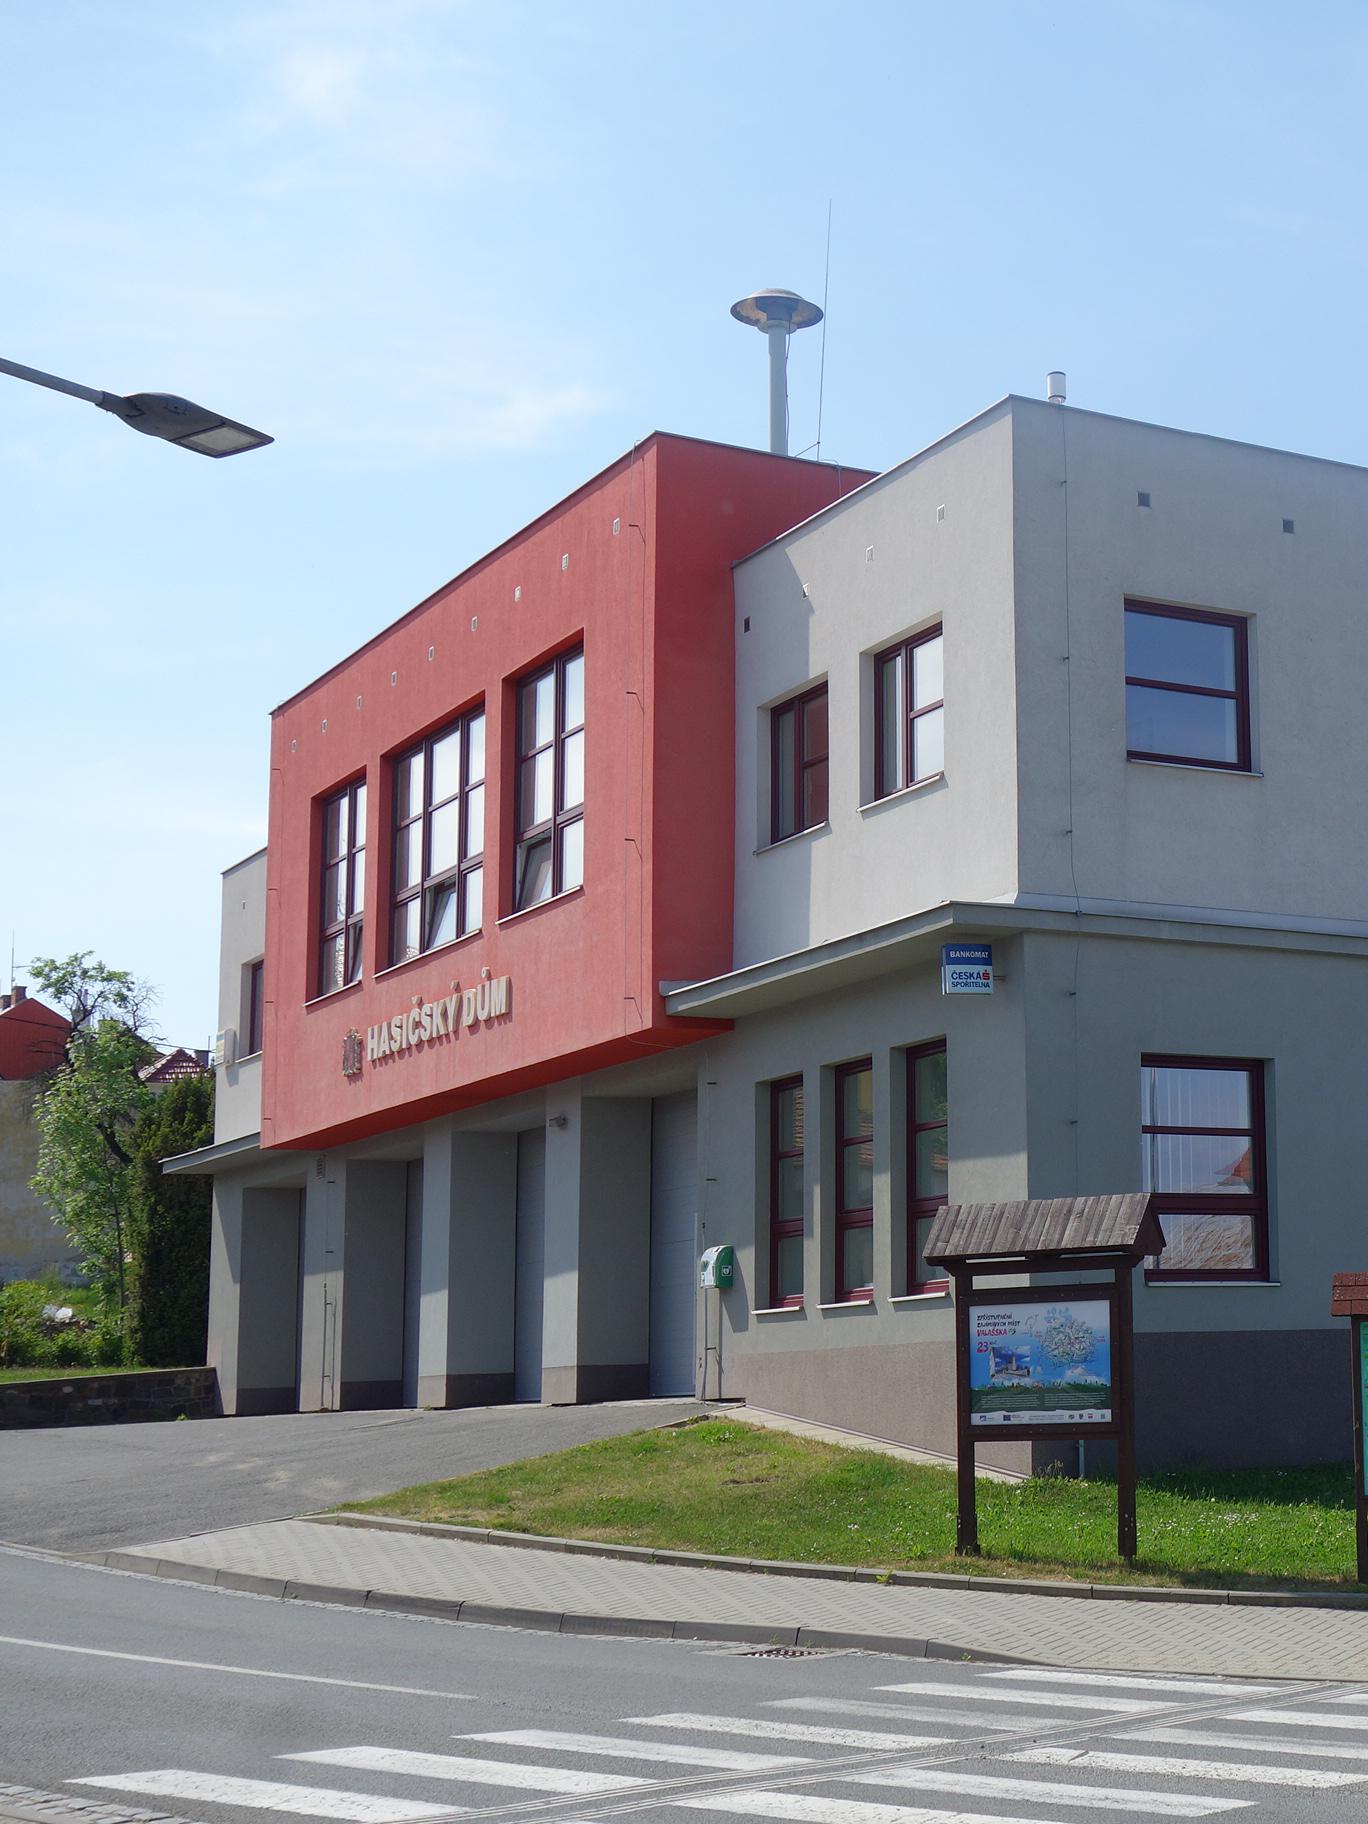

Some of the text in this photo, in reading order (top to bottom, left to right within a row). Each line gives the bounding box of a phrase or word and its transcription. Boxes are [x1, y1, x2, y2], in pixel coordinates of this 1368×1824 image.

[950, 950, 989, 959] BANKOMAT
[367, 966, 511, 1061] HASIČSKÝ DŮM
[976, 1341, 989, 1353] 23
